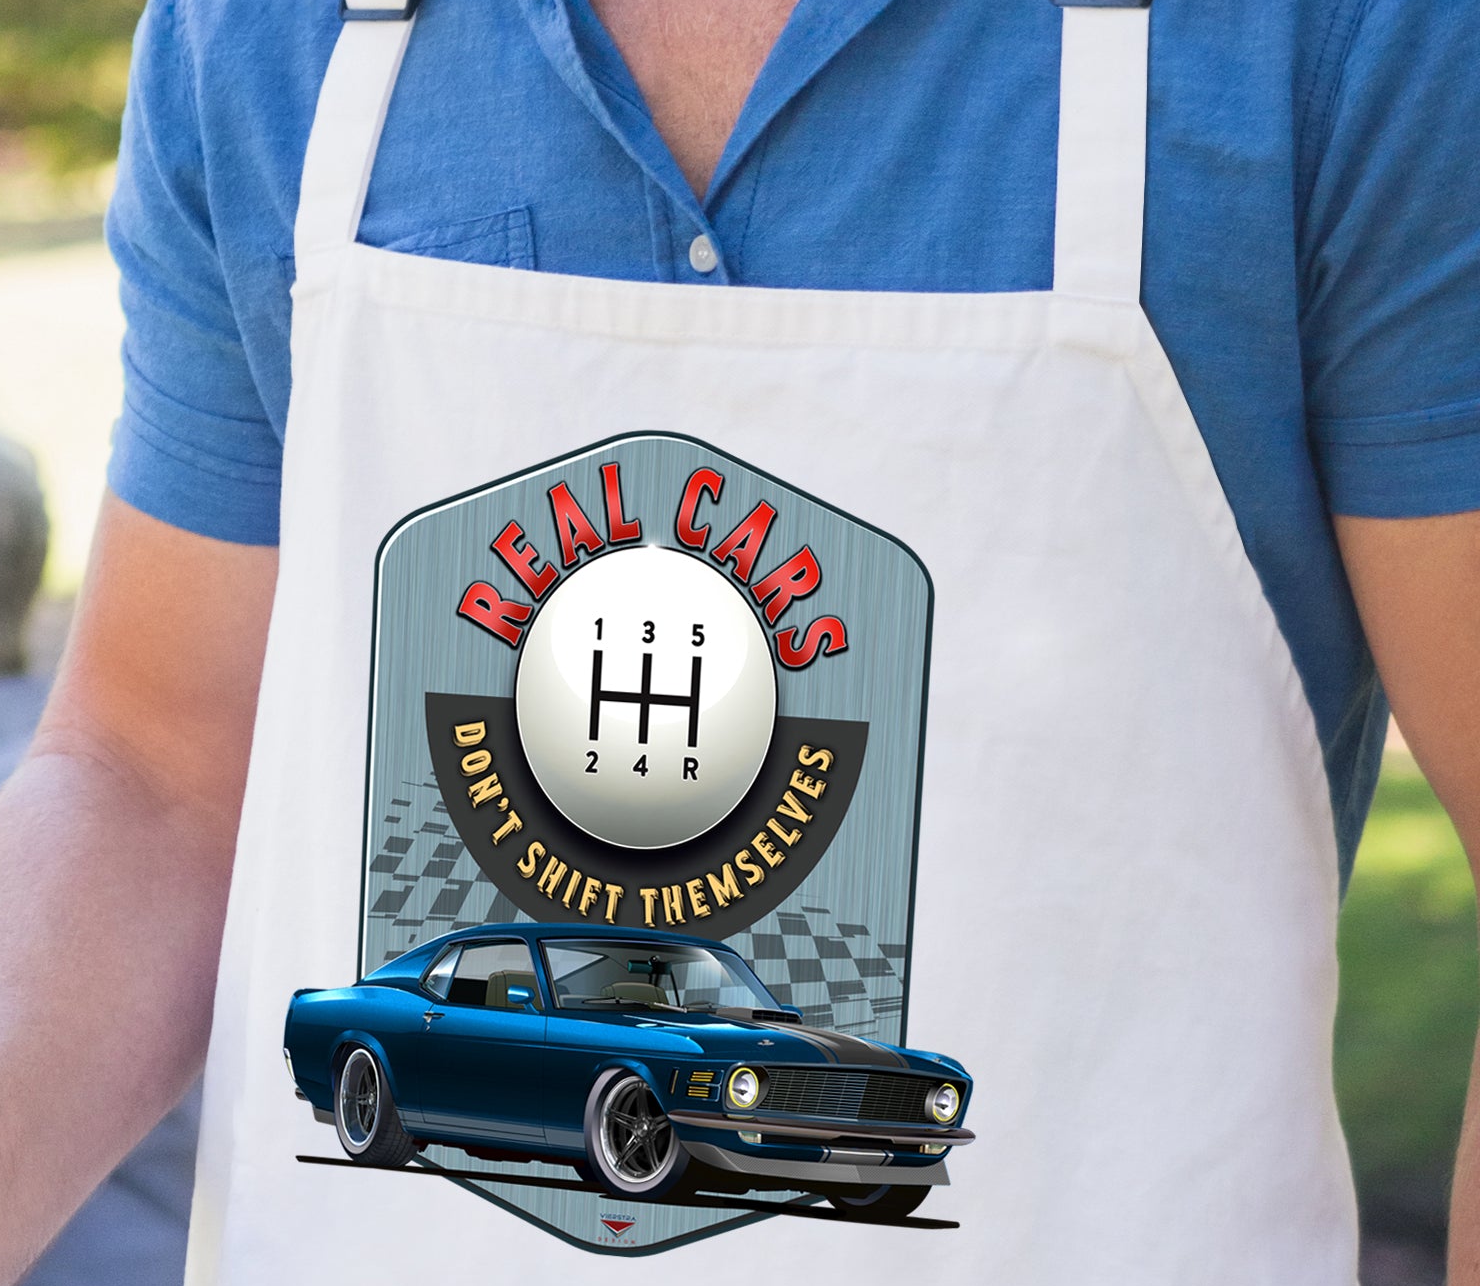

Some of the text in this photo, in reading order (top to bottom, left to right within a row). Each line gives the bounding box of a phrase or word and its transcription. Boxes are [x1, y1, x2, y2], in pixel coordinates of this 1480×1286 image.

[458, 462, 848, 669] REAL CARS
[594, 617, 705, 647] 1 3 5
[454, 719, 834, 927] DON'T SHIFT THEMSELVES
[585, 751, 699, 781] 2 4 R
